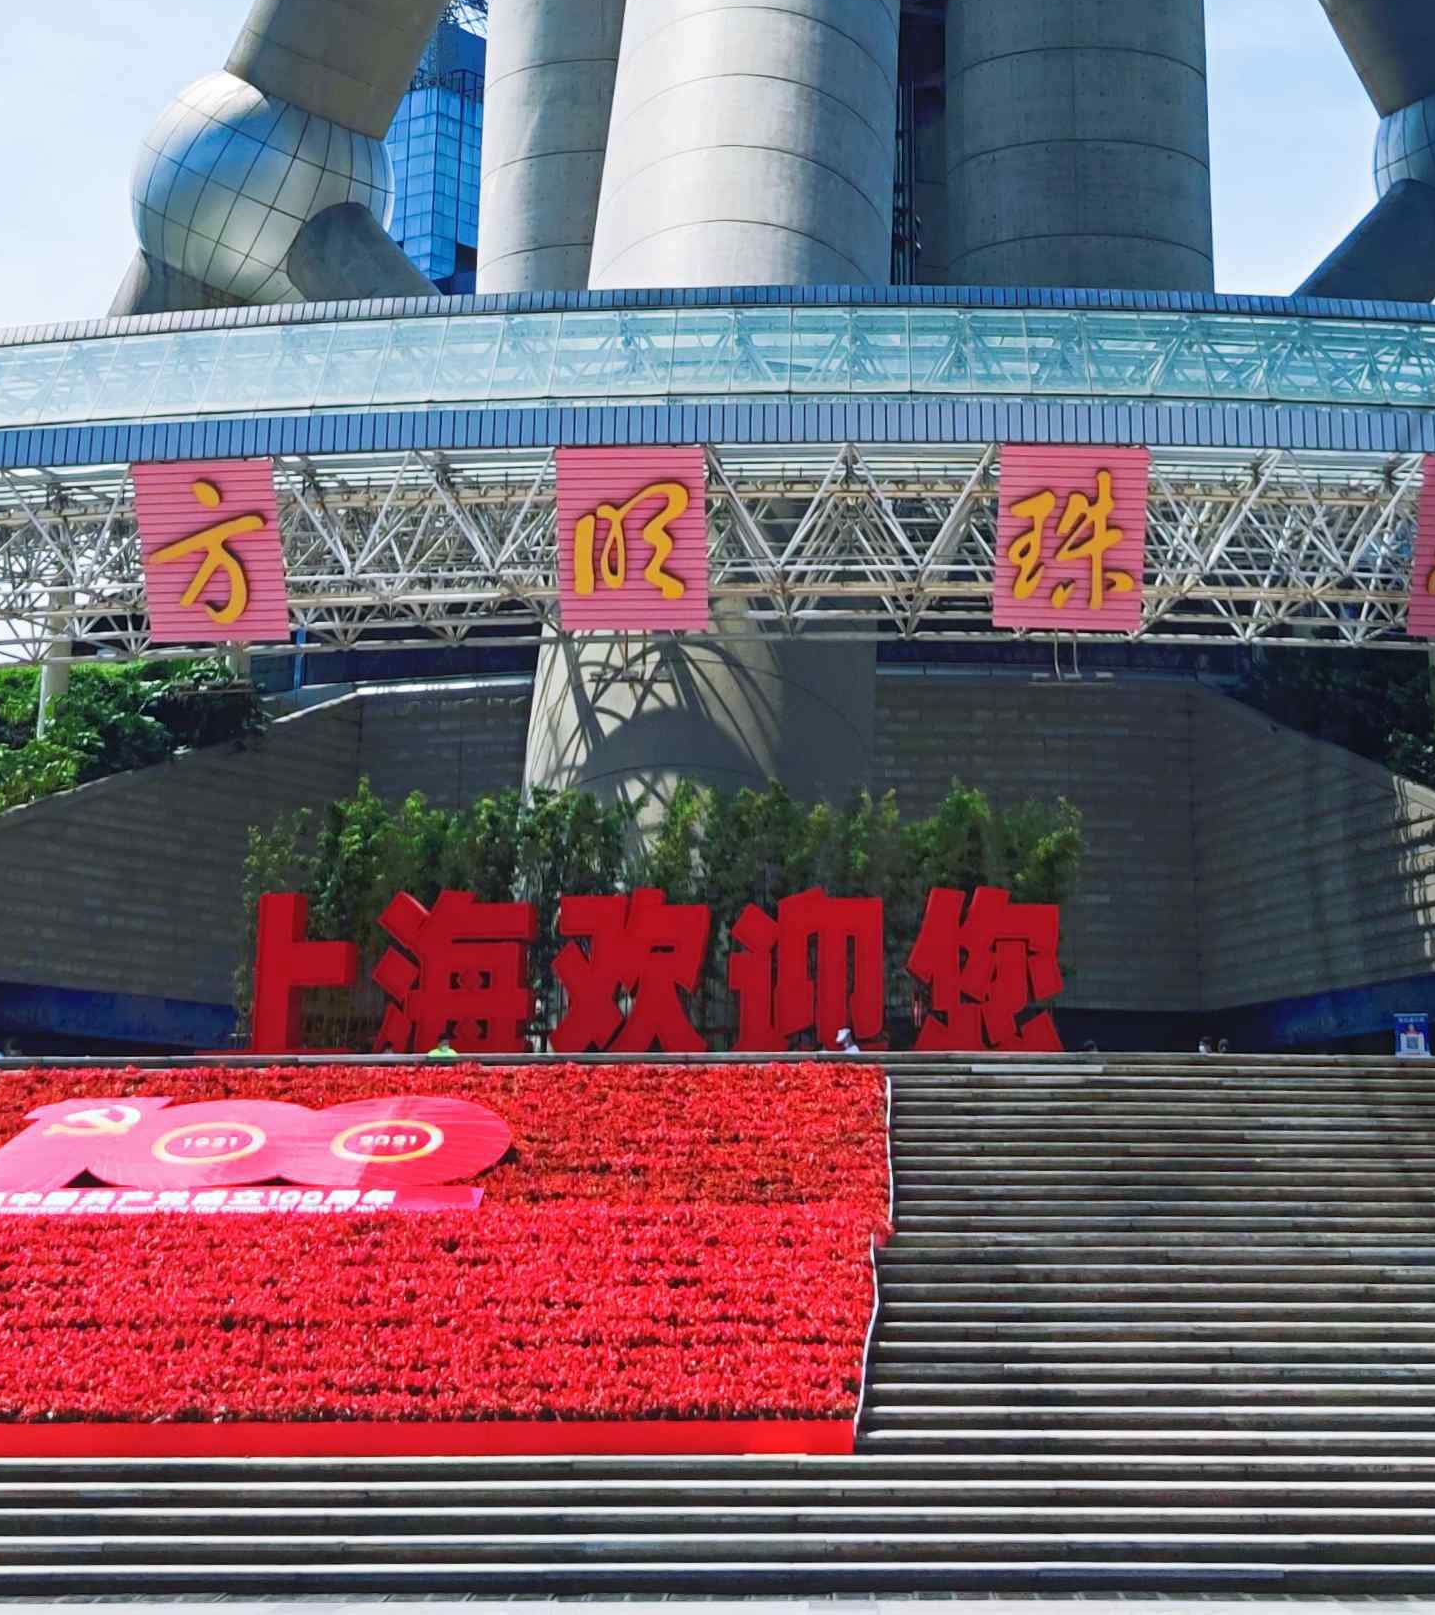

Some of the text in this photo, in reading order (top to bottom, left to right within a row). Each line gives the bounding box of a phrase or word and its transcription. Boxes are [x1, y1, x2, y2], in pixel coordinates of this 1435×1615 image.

[250, 886, 1064, 1052] 上海欢迎您
[182, 1135, 239, 1149] 1921
[359, 1134, 418, 1147] 2021
